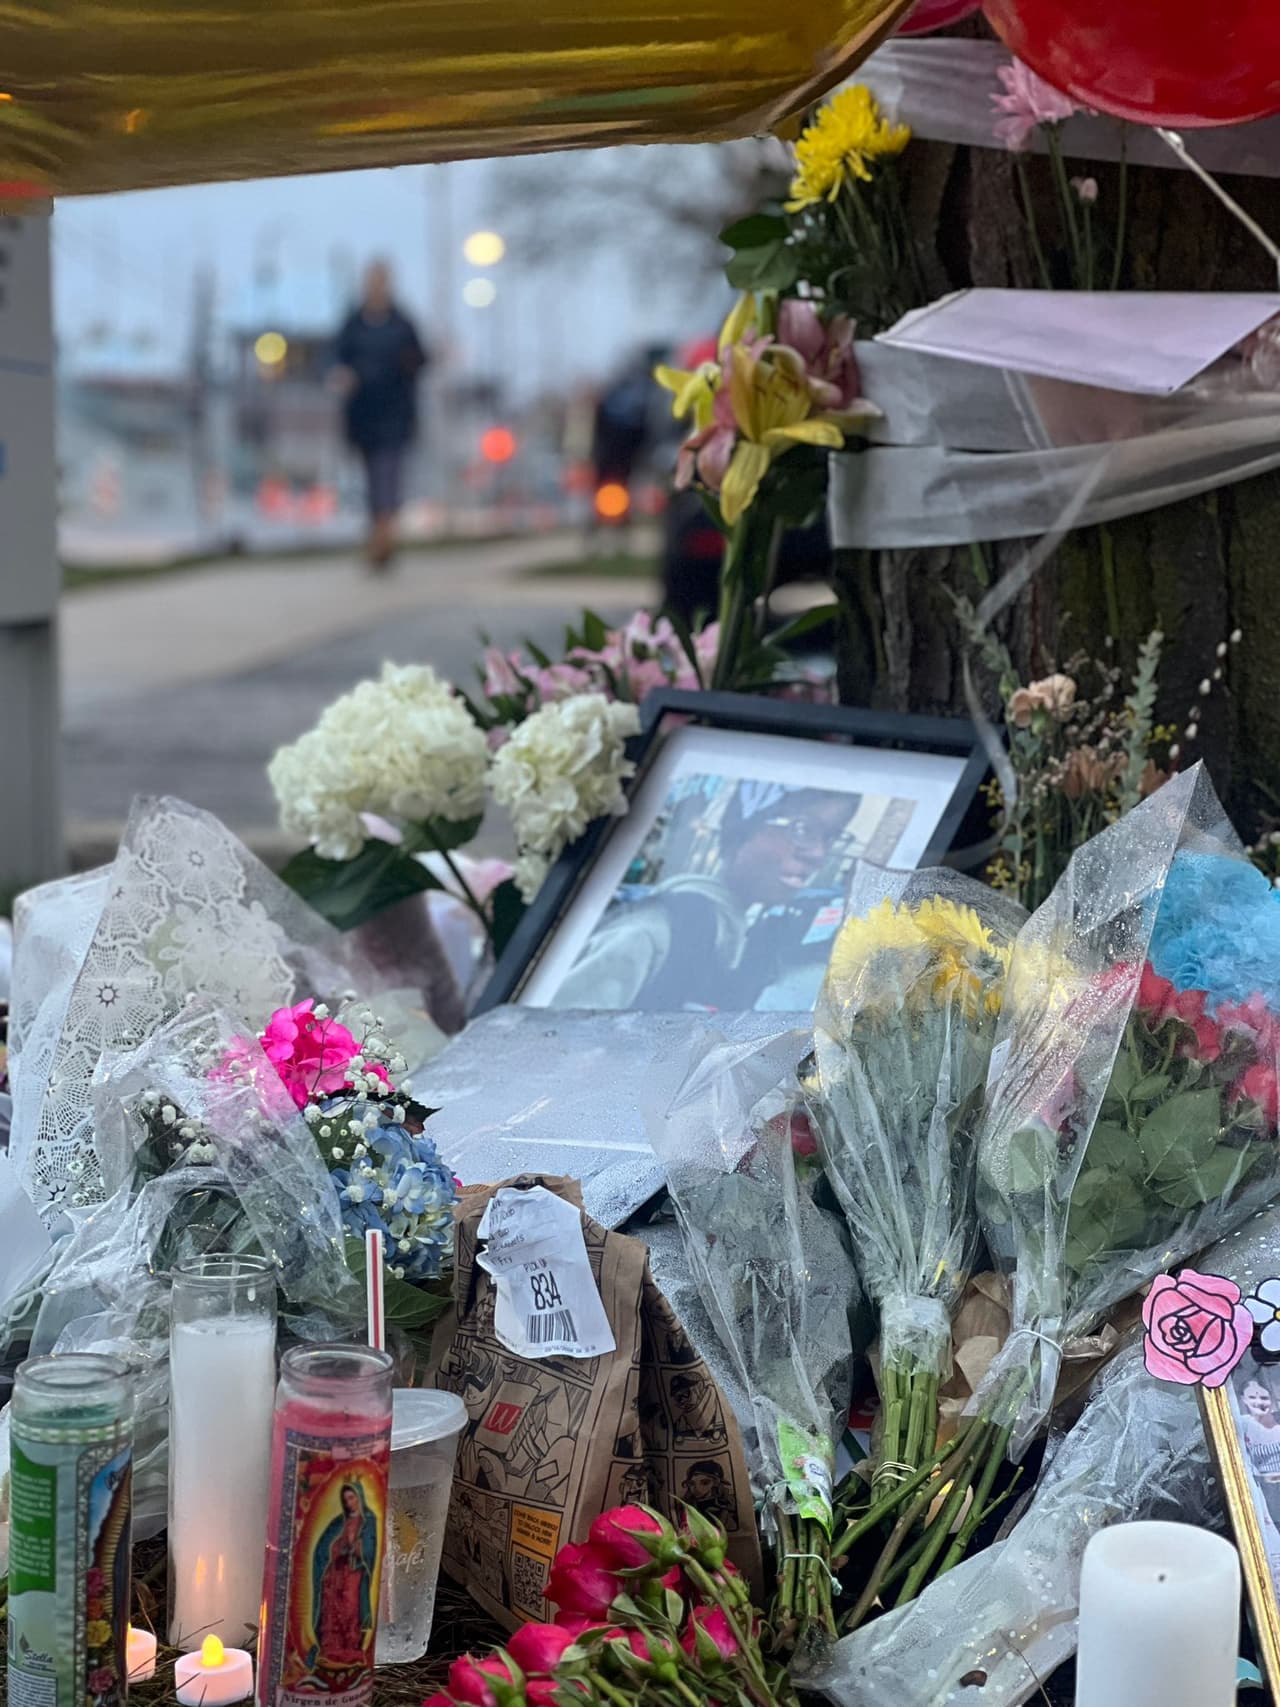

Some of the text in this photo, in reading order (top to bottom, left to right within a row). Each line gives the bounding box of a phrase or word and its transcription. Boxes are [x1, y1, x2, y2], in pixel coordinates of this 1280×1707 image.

[530, 1271, 562, 1311] 834
[284, 1693, 323, 1706] Virgen
[325, 1698, 337, 1706] de
